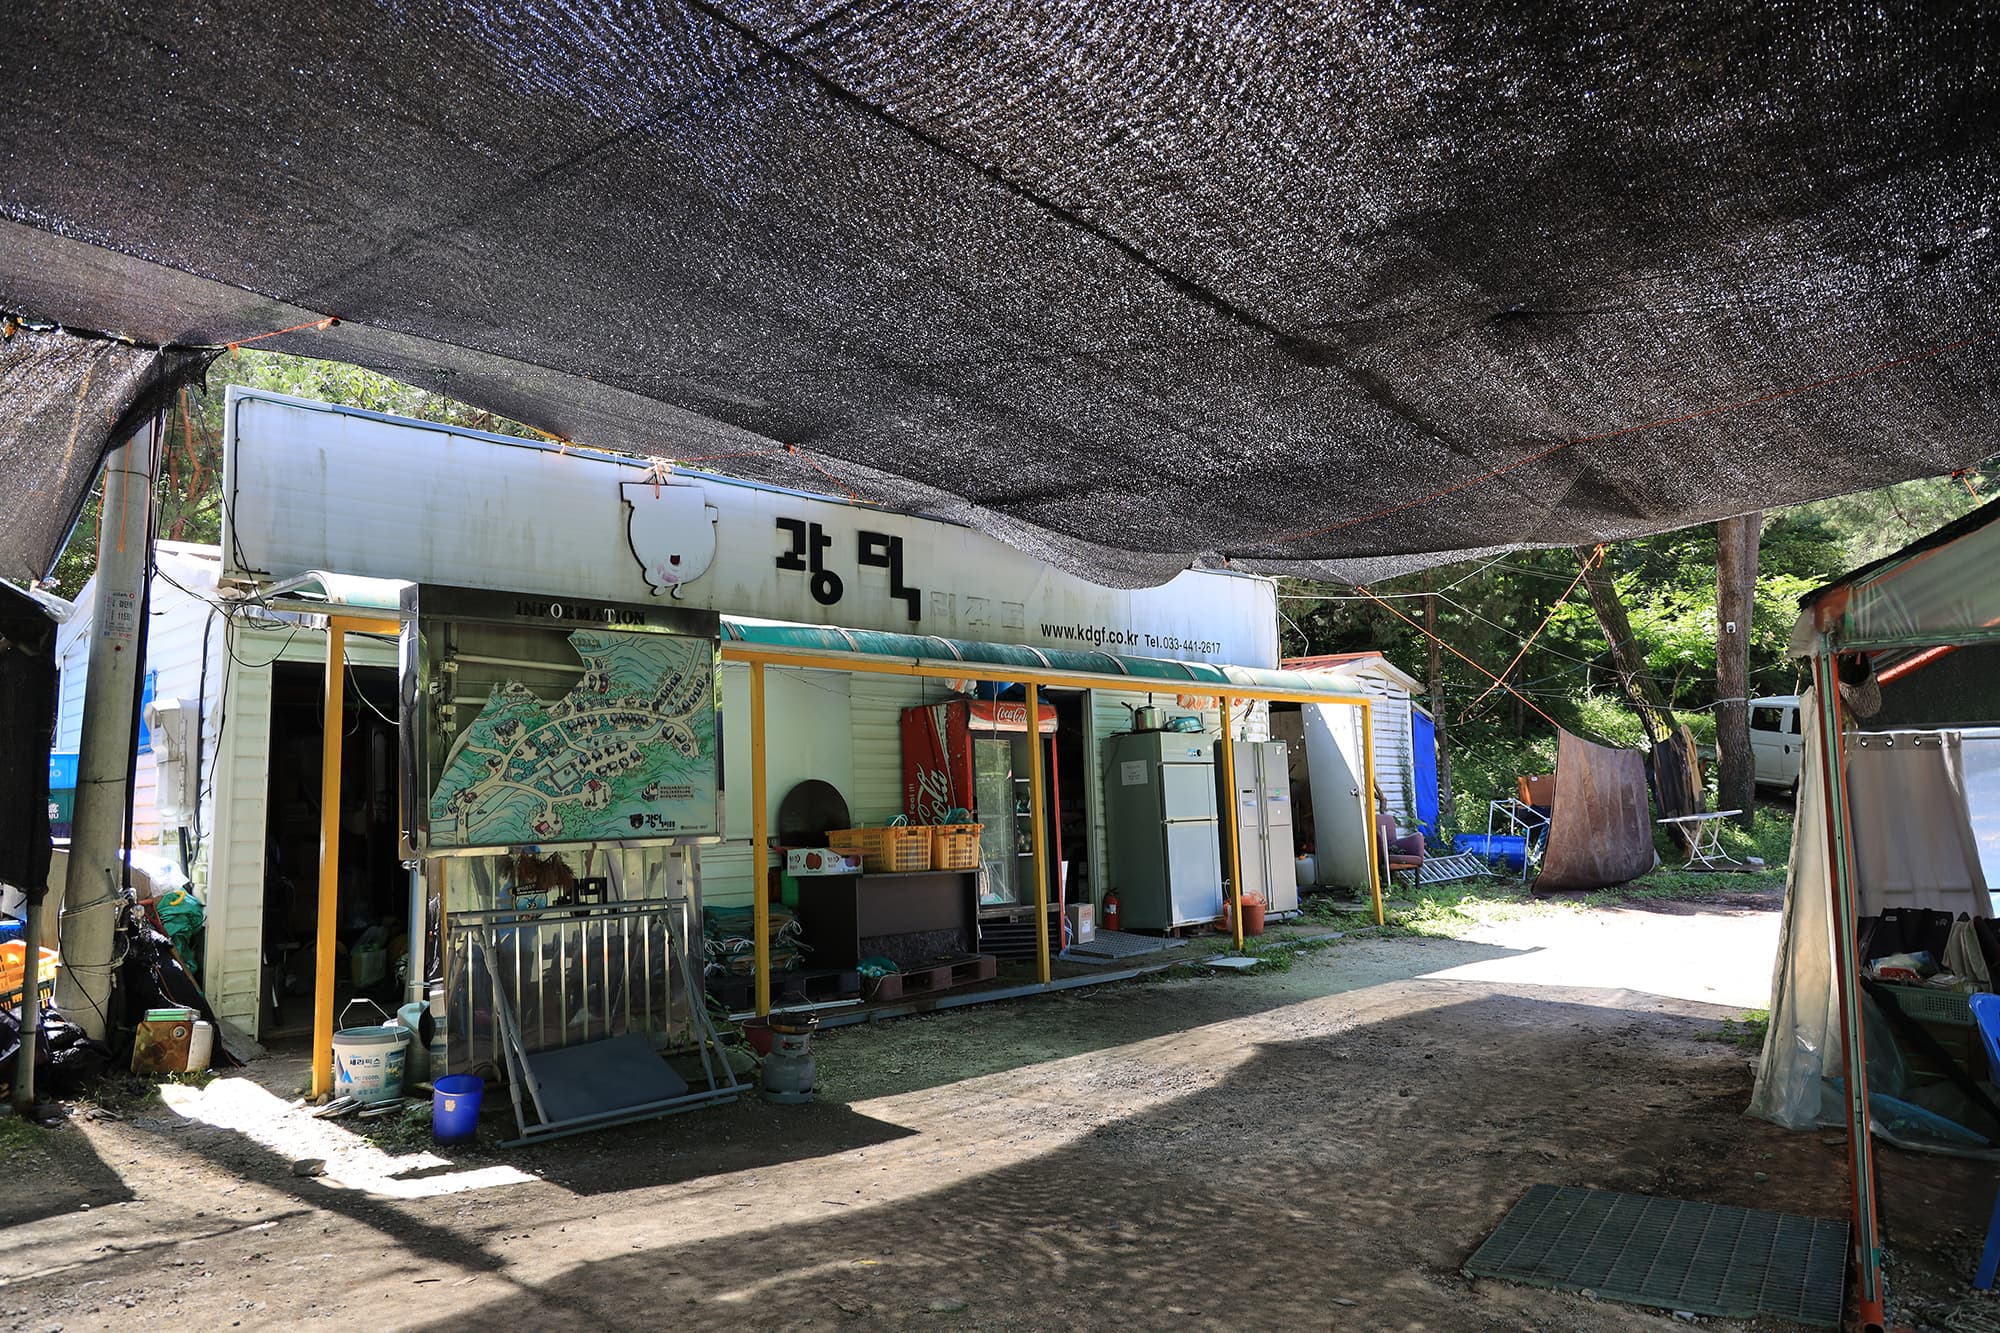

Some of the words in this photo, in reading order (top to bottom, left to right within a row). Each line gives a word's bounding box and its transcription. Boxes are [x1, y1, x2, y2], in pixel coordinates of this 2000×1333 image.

[776, 517, 921, 621] 광덕
[516, 600, 646, 625] INFORMATION
[1041, 624, 1138, 646] www.kdgf.co.kr
